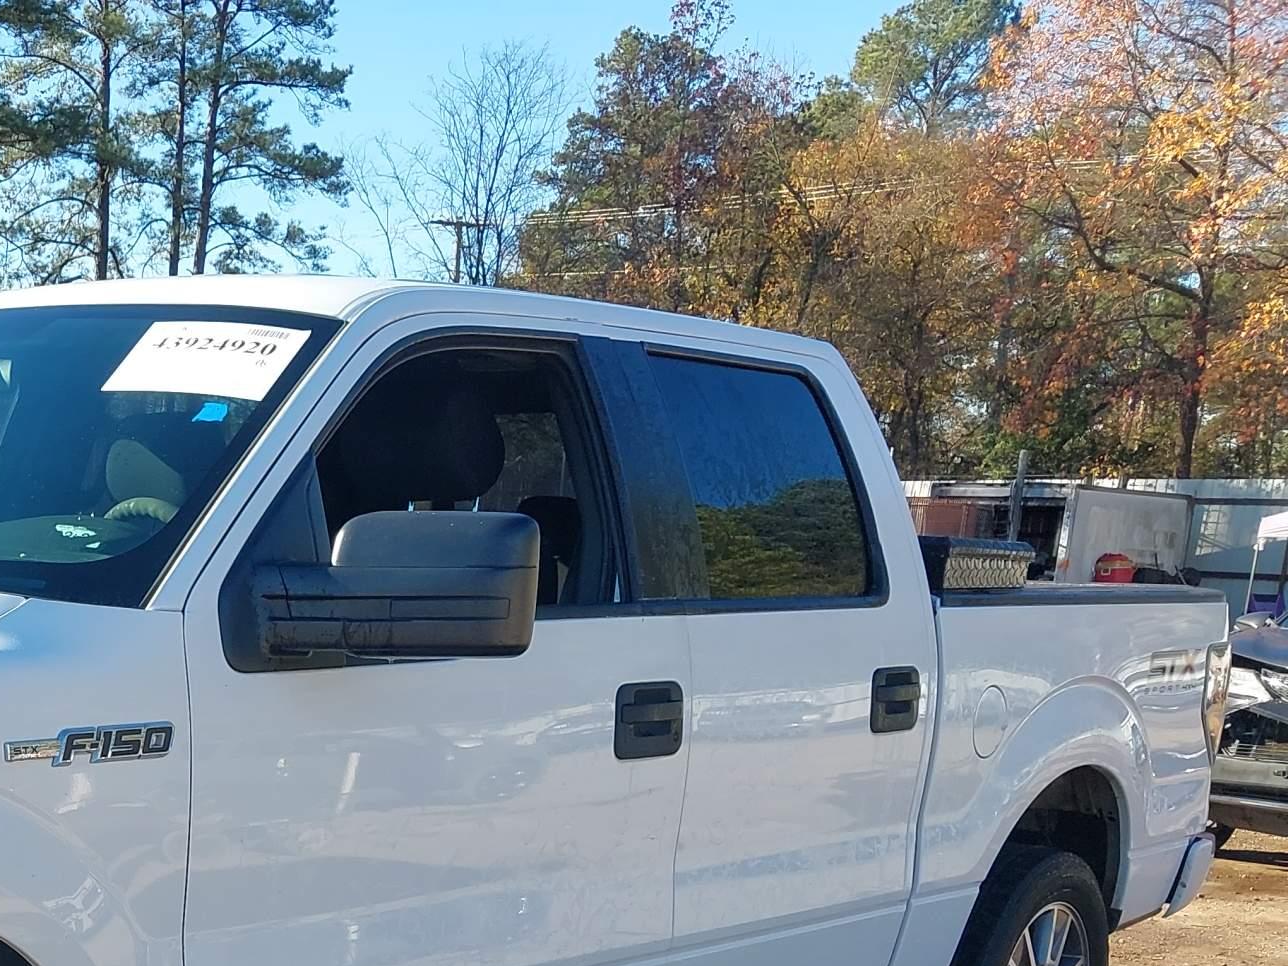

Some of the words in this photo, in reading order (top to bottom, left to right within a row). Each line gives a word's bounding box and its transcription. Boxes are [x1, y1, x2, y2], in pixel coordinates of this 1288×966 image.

[153, 336, 277, 356] 43924920
[13, 744, 39, 755] STX
[60, 725, 174, 762] F-150
